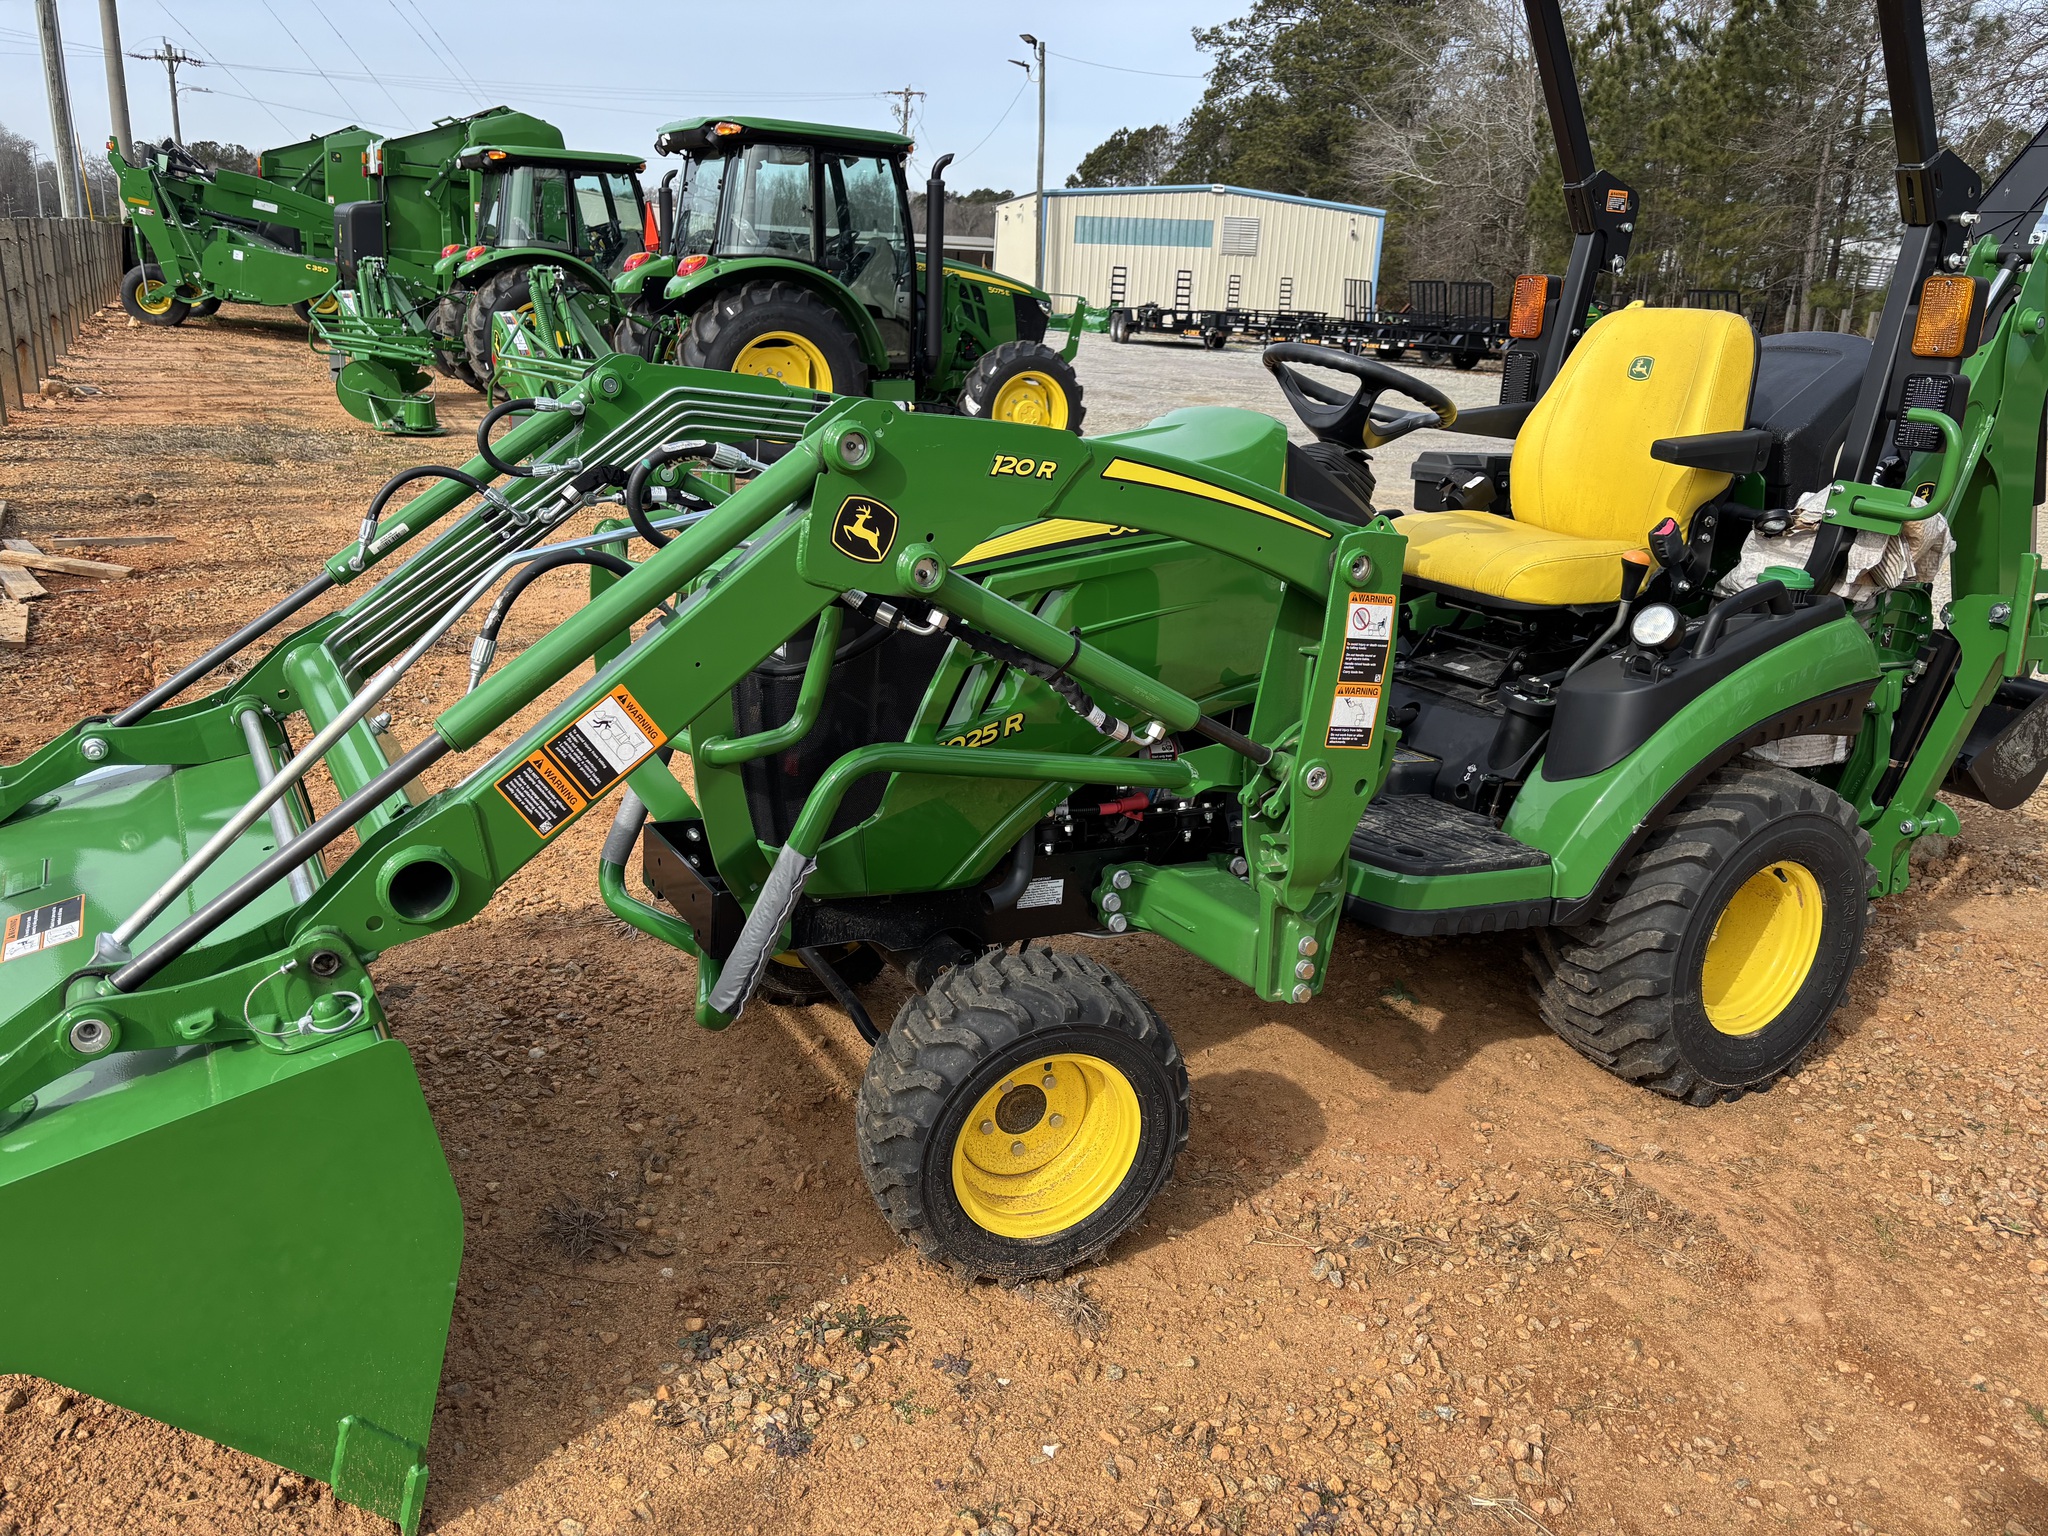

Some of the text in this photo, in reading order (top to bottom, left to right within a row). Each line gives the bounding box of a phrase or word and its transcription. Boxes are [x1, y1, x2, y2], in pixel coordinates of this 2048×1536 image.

[312, 265, 329, 273] 350
[990, 454, 1058, 479] 120 R
[1359, 594, 1393, 604] WARNING
[1345, 687, 1378, 695] WARNING
[624, 701, 658, 739] WARNING
[939, 712, 1025, 748] 025 R
[542, 767, 578, 805] WARNING
